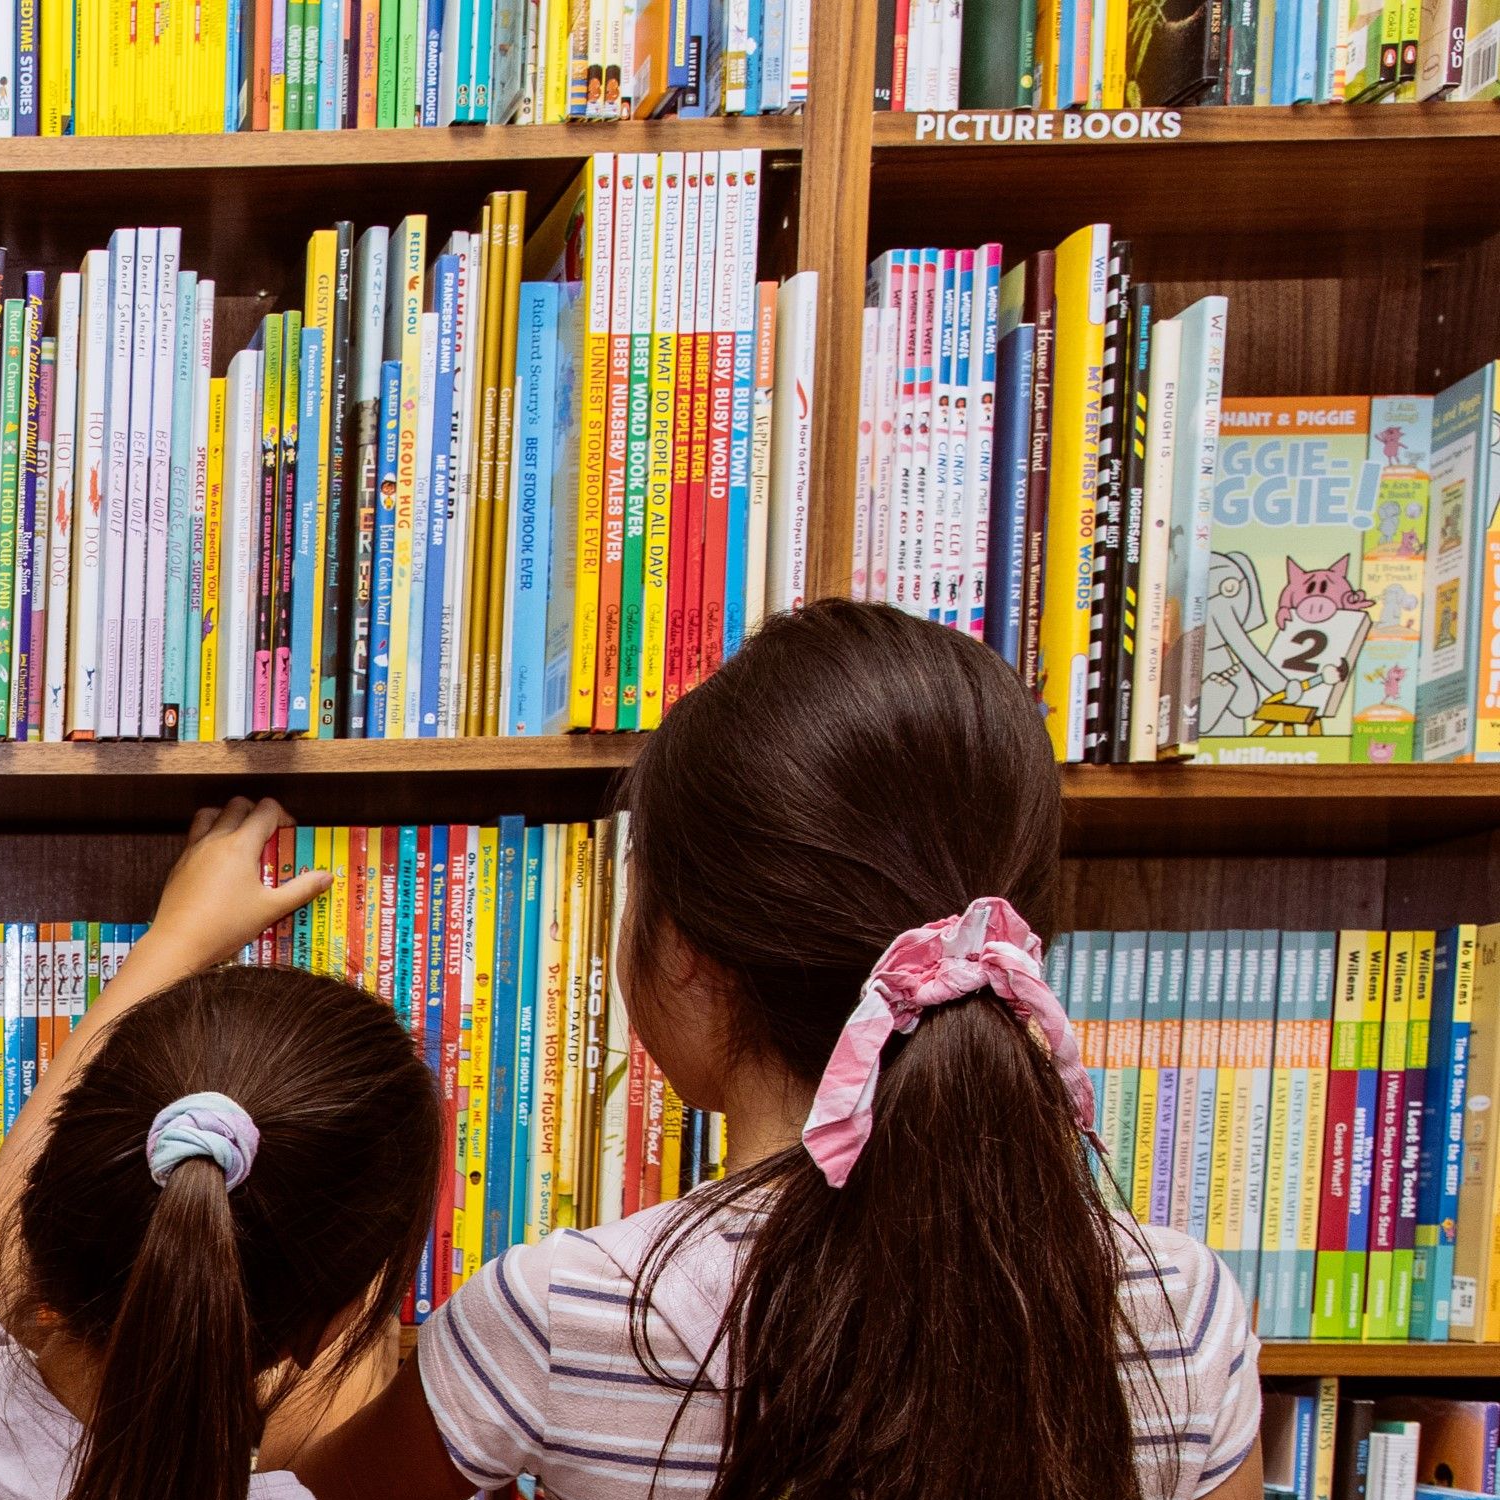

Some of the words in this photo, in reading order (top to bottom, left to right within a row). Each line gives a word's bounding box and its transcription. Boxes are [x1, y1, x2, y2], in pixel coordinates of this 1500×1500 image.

[425, 40, 438, 82] RANDOM
[18, 53, 33, 116] STORIES
[425, 86, 437, 124] HOUSE
[916, 113, 1053, 141] PICTURE
[1063, 111, 1182, 139] BOOKS
[612, 337, 630, 378] BEST
[633, 336, 650, 378] BEST
[656, 336, 672, 385] WHAT
[714, 335, 732, 383] BUSY,
[1088, 366, 1102, 394] MY
[609, 382, 628, 463] NURSERY
[631, 381, 649, 438] WORD
[655, 391, 670, 414] DO
[712, 388, 730, 434] BUSY
[1083, 401, 1101, 447] VERY
[1296, 409, 1356, 425] PIGGIE
[399, 430, 415, 487] GROUP
[629, 441, 646, 489] BOOK
[653, 420, 669, 478] PEOPLE
[709, 437, 728, 500] WORLD
[607, 466, 624, 522] TALES
[651, 483, 666, 506] DO
[1081, 452, 1100, 500] FIRST
[1, 485, 15, 525] HOLD
[397, 495, 411, 529] HUG
[627, 494, 645, 538] EVER
[650, 512, 665, 539] ALL
[1079, 507, 1095, 539] 100
[0, 527, 14, 567] YOUR
[605, 524, 622, 564] EVER
[648, 545, 664, 588] DAY?
[1076, 543, 1094, 611] WORDS
[1281, 628, 1329, 674] 2
[1345, 950, 1361, 1002] Willems
